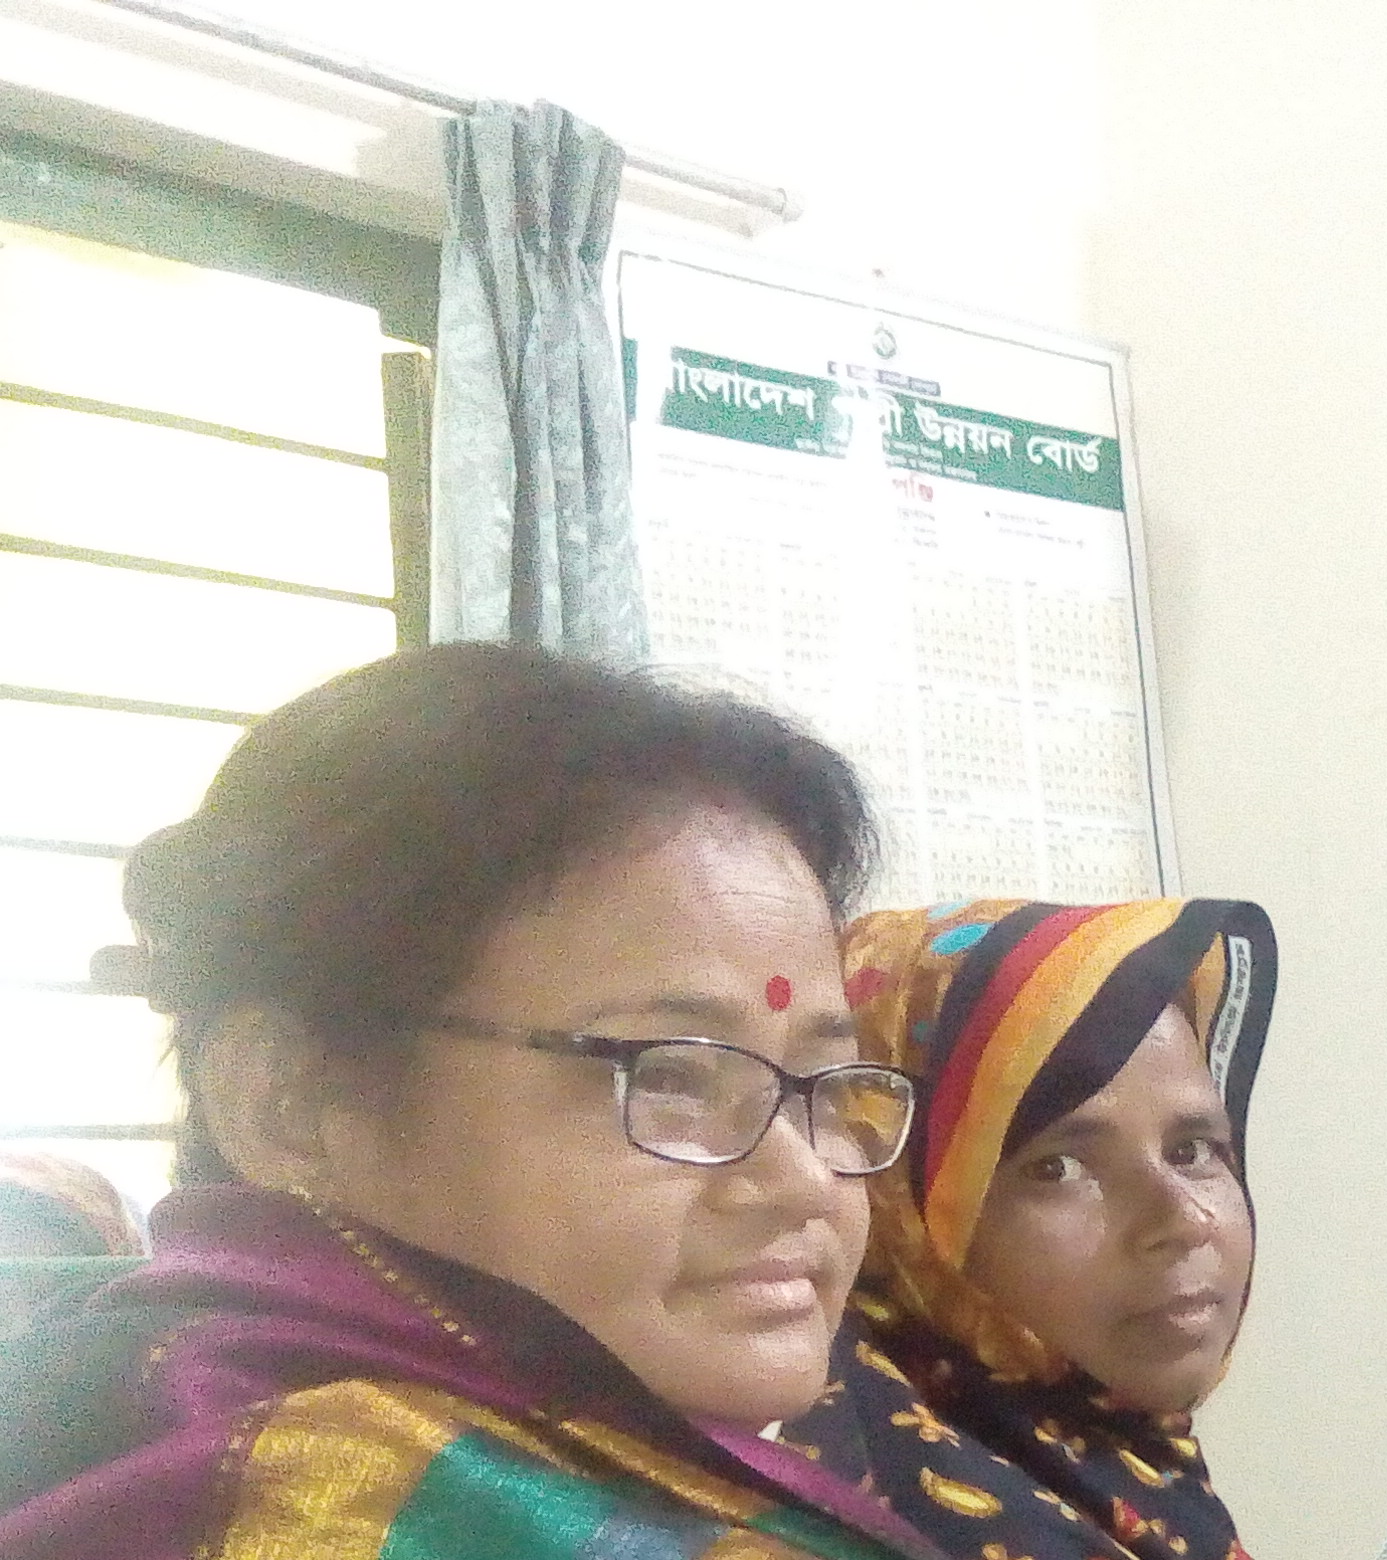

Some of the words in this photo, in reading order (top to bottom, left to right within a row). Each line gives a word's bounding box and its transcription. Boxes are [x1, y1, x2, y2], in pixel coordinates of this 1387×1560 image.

[664, 356, 815, 421] াংলাদেশ
[914, 400, 1014, 460] উন্নয়ন
[1027, 434, 1102, 473] বোর্ড
